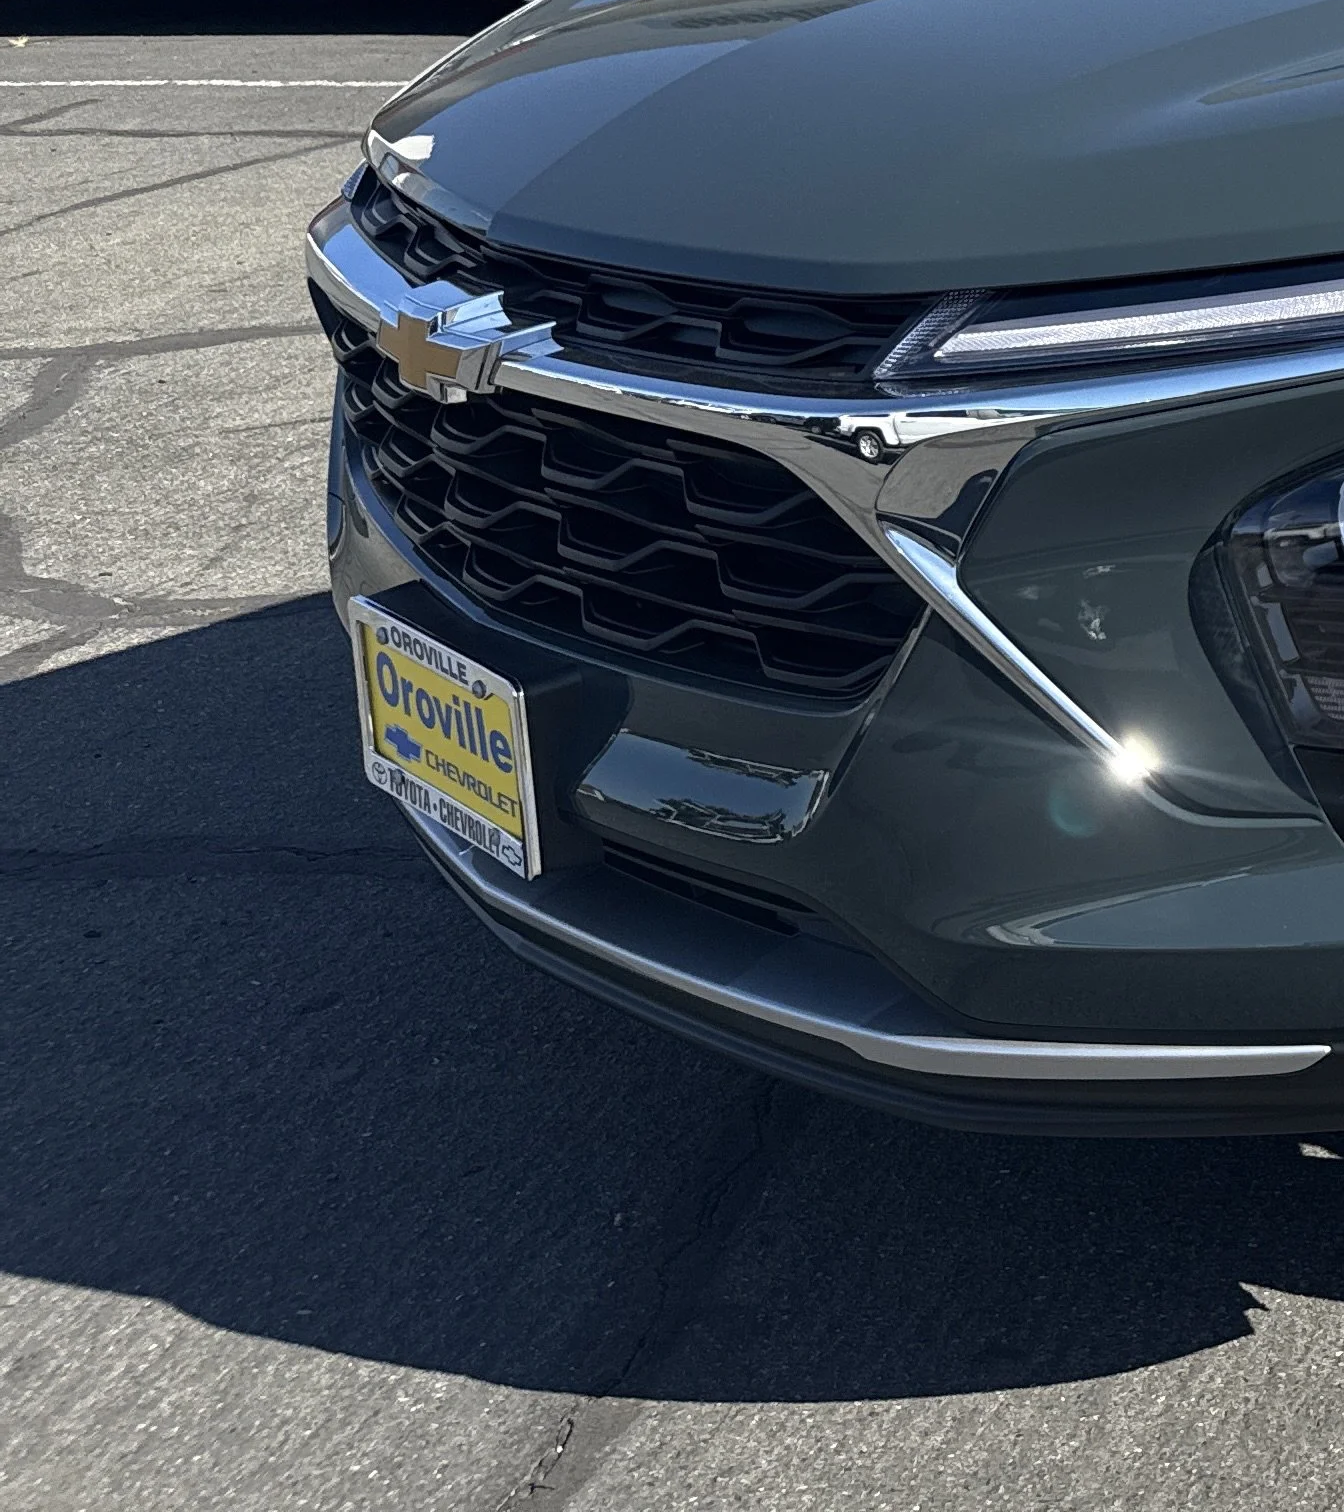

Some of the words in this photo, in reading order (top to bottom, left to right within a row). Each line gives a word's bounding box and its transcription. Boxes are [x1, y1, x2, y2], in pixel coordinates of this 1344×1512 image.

[390, 625, 469, 686] OROVILLE
[376, 651, 514, 774] Oroville
[425, 749, 518, 817] CHEVROLET
